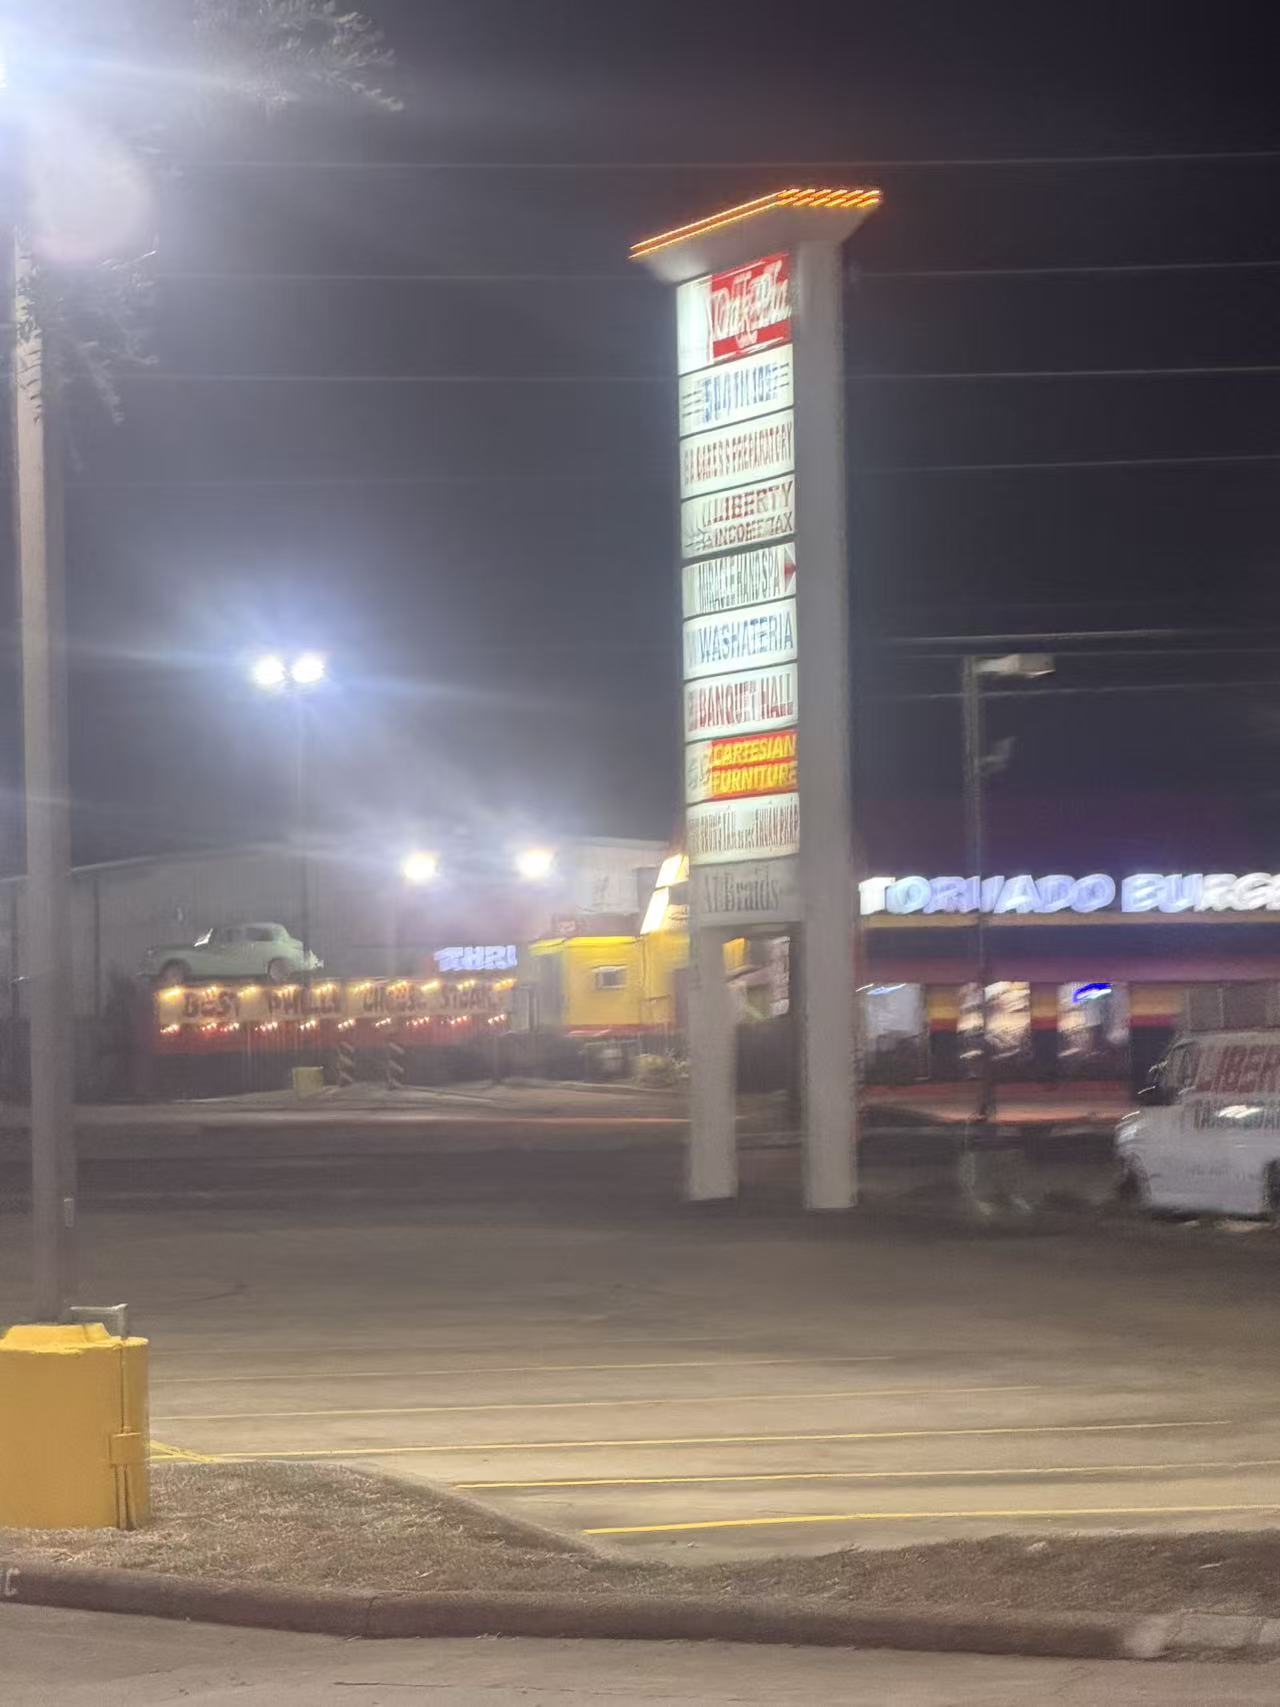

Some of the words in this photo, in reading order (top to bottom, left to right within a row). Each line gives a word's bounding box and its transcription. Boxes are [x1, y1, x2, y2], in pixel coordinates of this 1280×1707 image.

[713, 480, 793, 524] LIBERTY
[714, 519, 765, 548] INCOME
[766, 511, 793, 537] TAX
[698, 611, 794, 663] WASHATERIA
[698, 680, 757, 728] BANQUET
[760, 672, 794, 720] HALL
[711, 762, 798, 795] FURNITURE
[858, 874, 1116, 915] TORNADO
